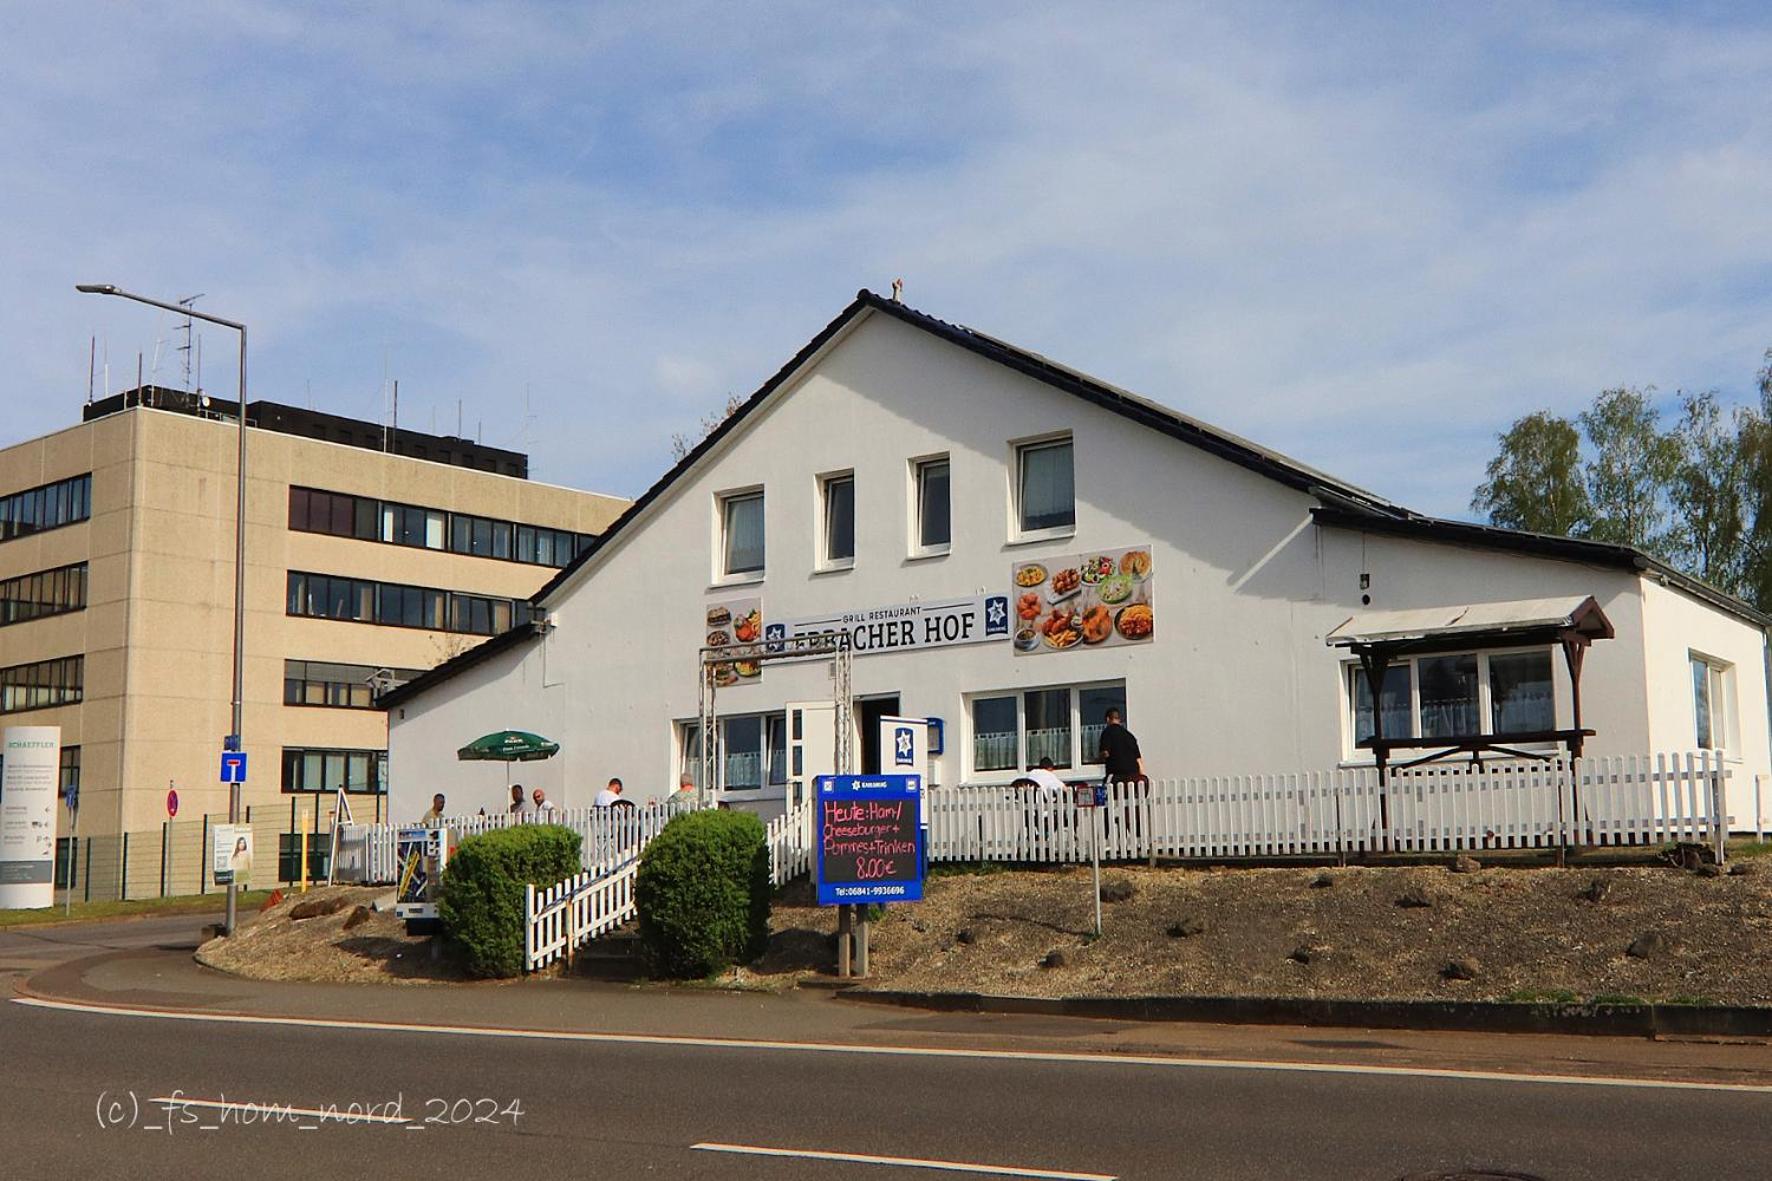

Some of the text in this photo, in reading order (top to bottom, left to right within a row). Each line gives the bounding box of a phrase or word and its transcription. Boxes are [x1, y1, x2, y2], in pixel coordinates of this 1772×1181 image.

[842, 606, 921, 624] GRILL RESTAURANT
[924, 612, 975, 642] HOF
